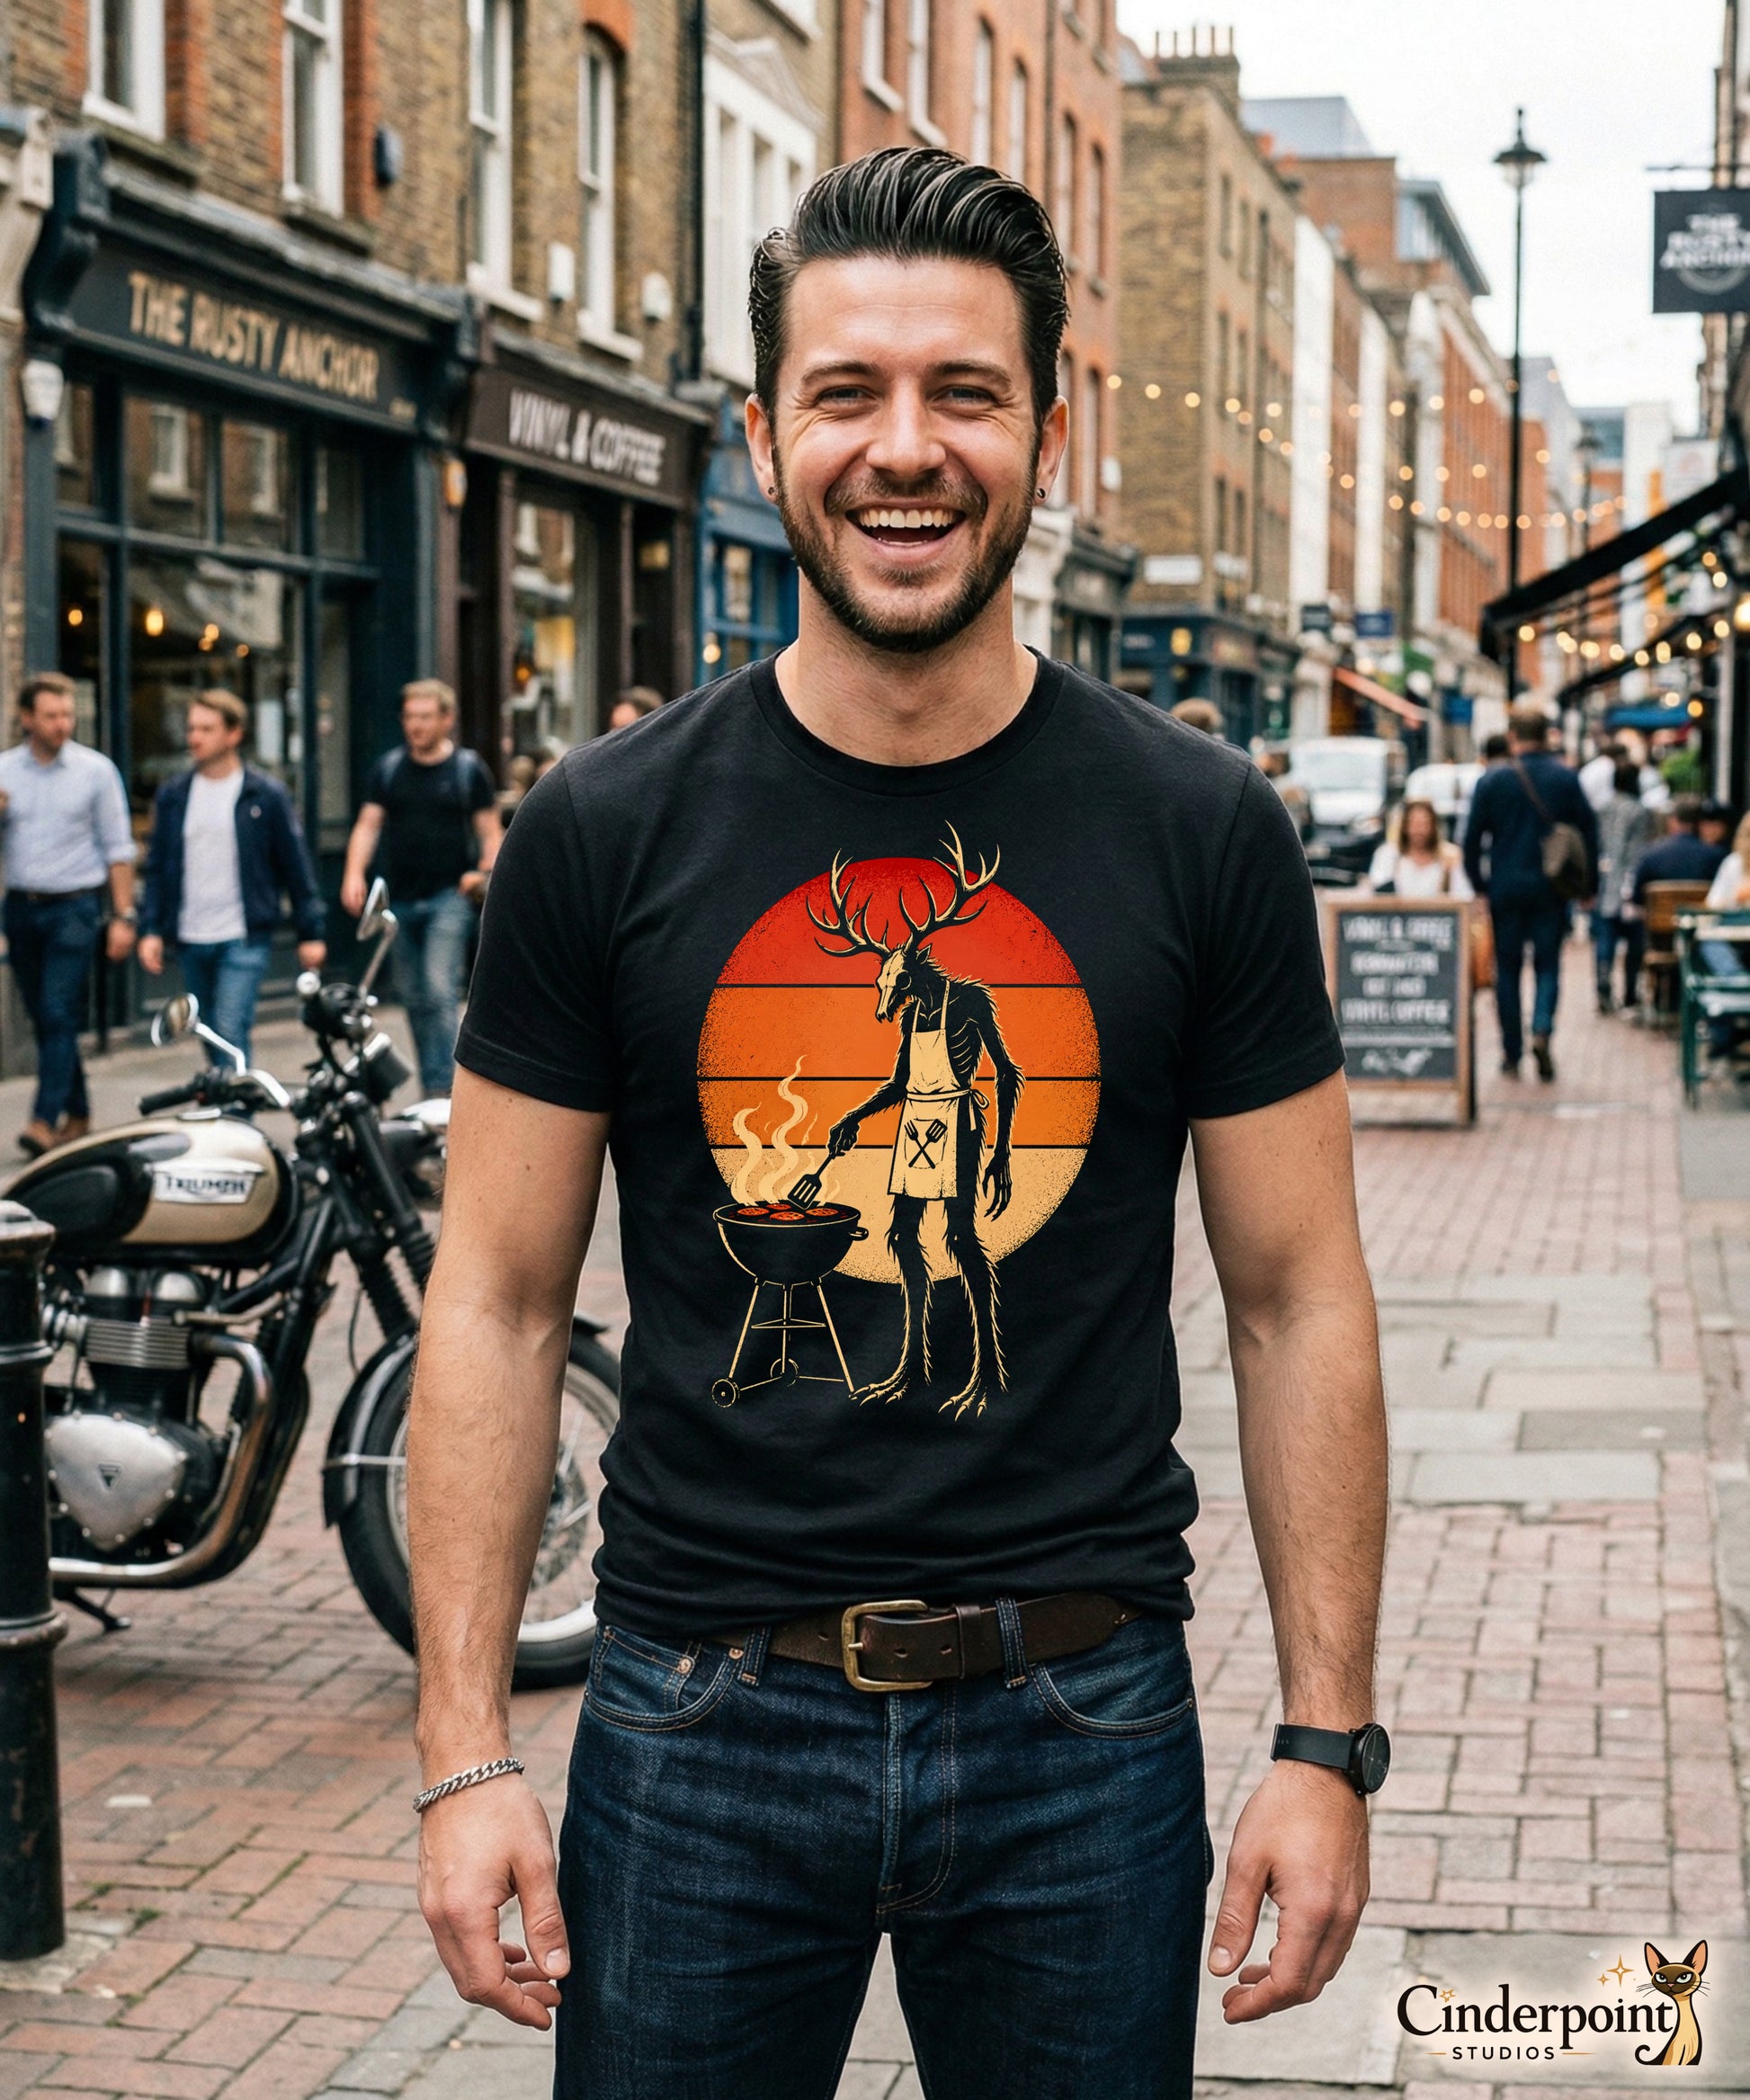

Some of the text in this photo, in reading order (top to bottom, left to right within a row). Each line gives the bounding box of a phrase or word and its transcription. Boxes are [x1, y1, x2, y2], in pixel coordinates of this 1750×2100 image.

[128, 270, 379, 402] THE RUSTY ANCHOR
[509, 388, 666, 487] VINYL & COFFEE
[165, 1175, 246, 1195] TRIUMPH
